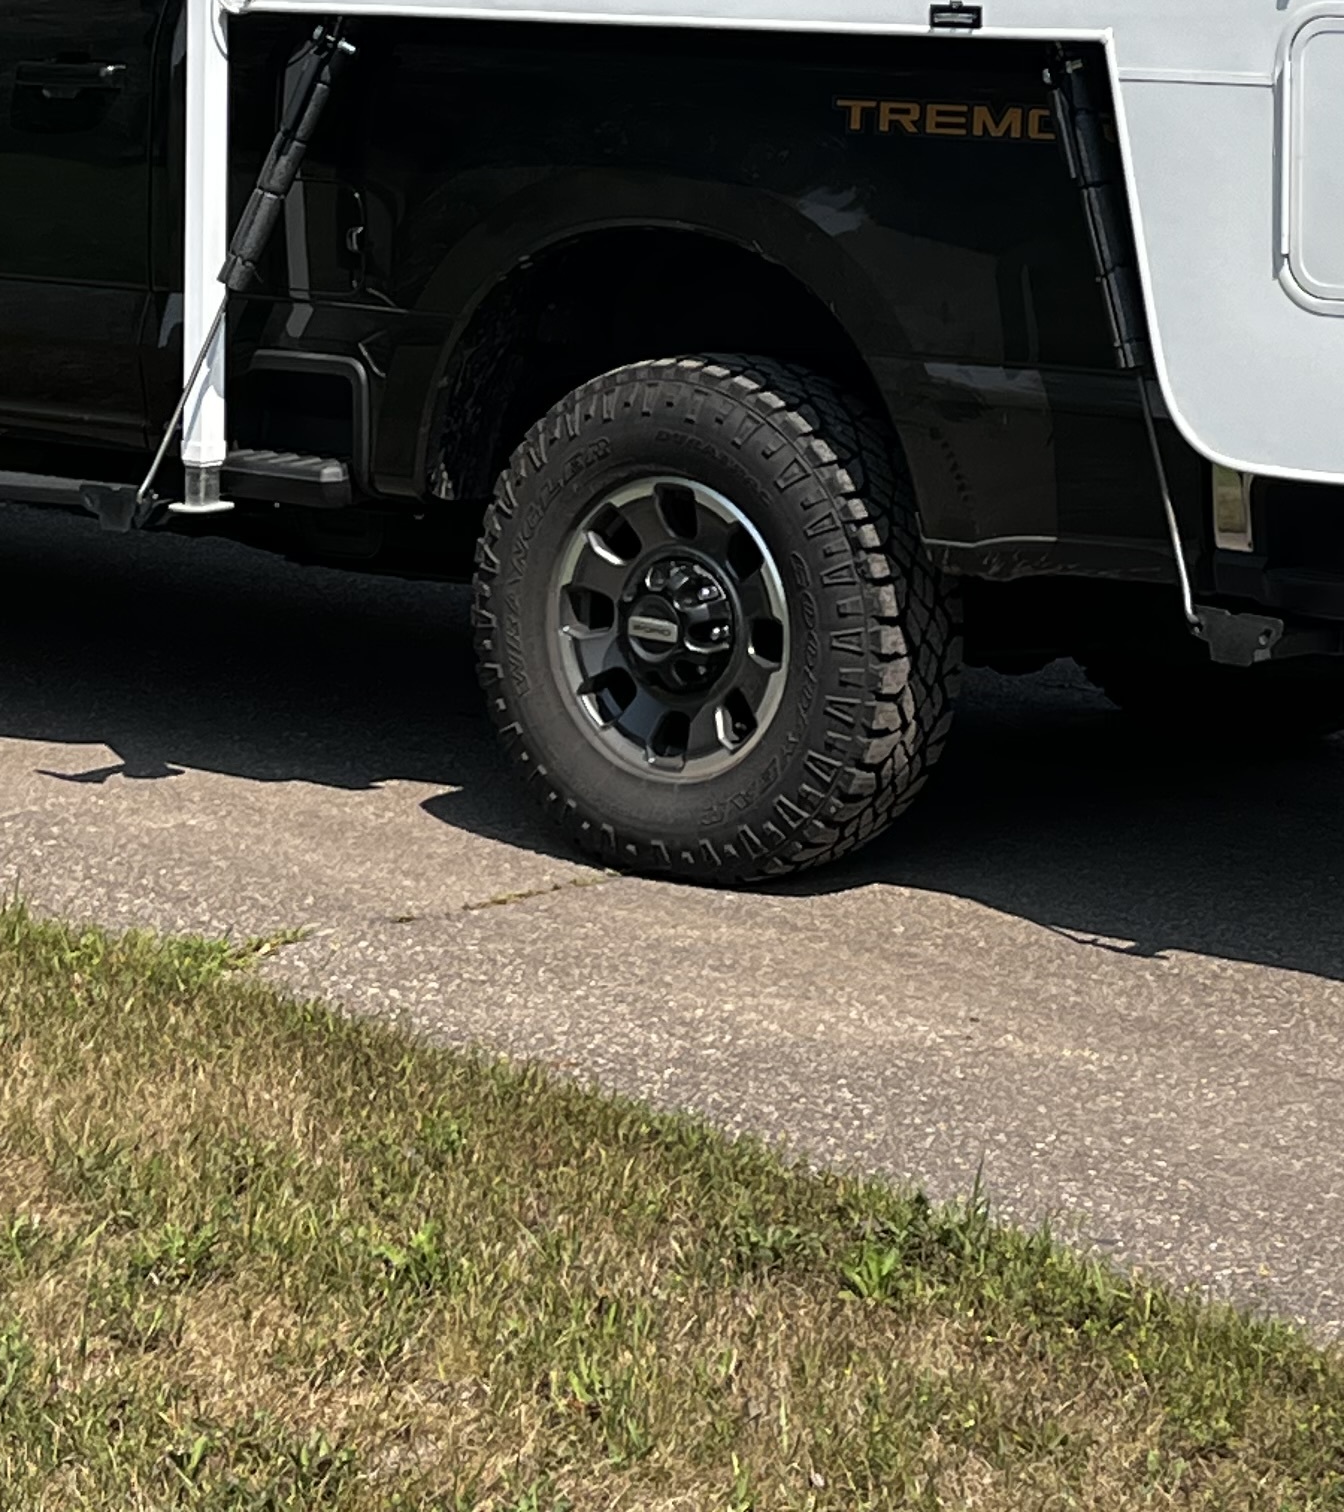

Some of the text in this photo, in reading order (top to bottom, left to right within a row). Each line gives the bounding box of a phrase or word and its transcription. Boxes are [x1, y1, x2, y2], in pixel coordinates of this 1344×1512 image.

[835, 98, 1058, 141] TREMO
[503, 437, 612, 697] WRANGLER
[700, 551, 821, 827] GOODYEAR
